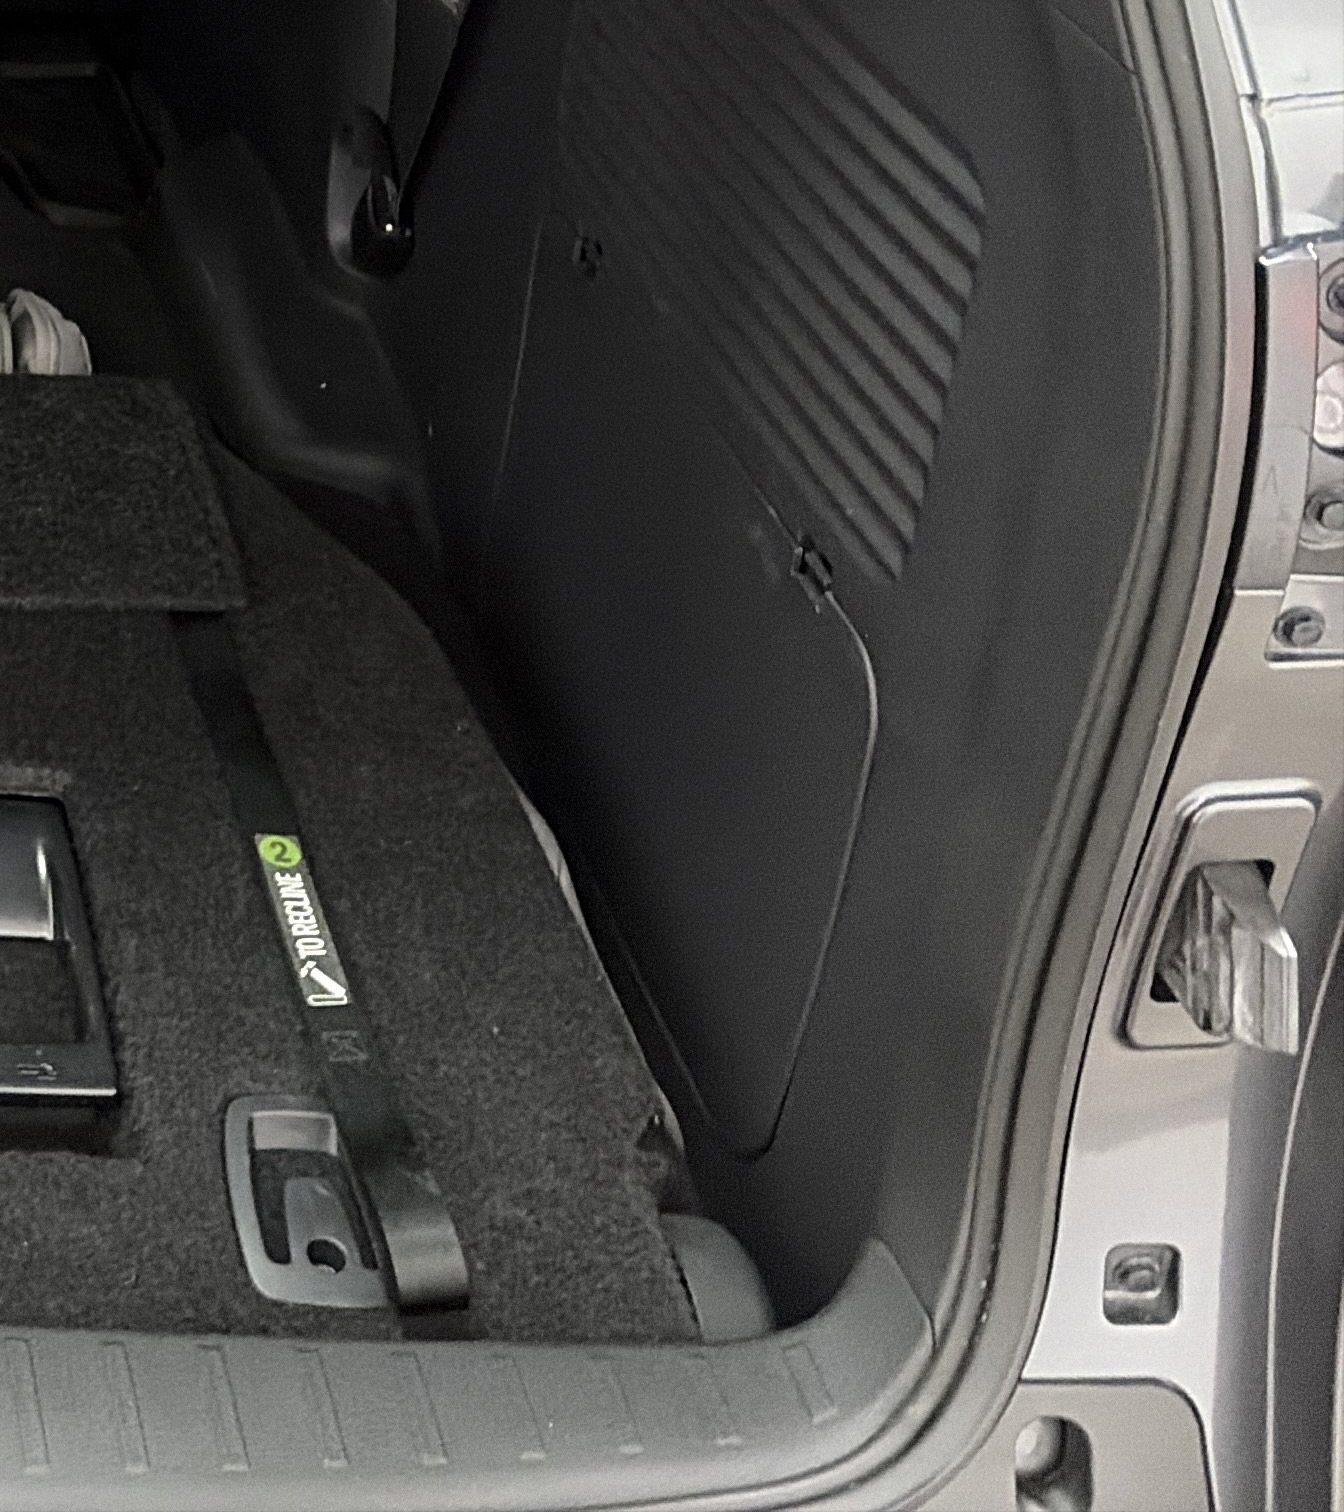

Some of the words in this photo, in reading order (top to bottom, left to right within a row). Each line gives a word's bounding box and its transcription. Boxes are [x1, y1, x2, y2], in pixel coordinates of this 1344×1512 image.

[269, 841, 292, 863] 2
[275, 872, 320, 937] RECLINE
[295, 937, 327, 960] TO
